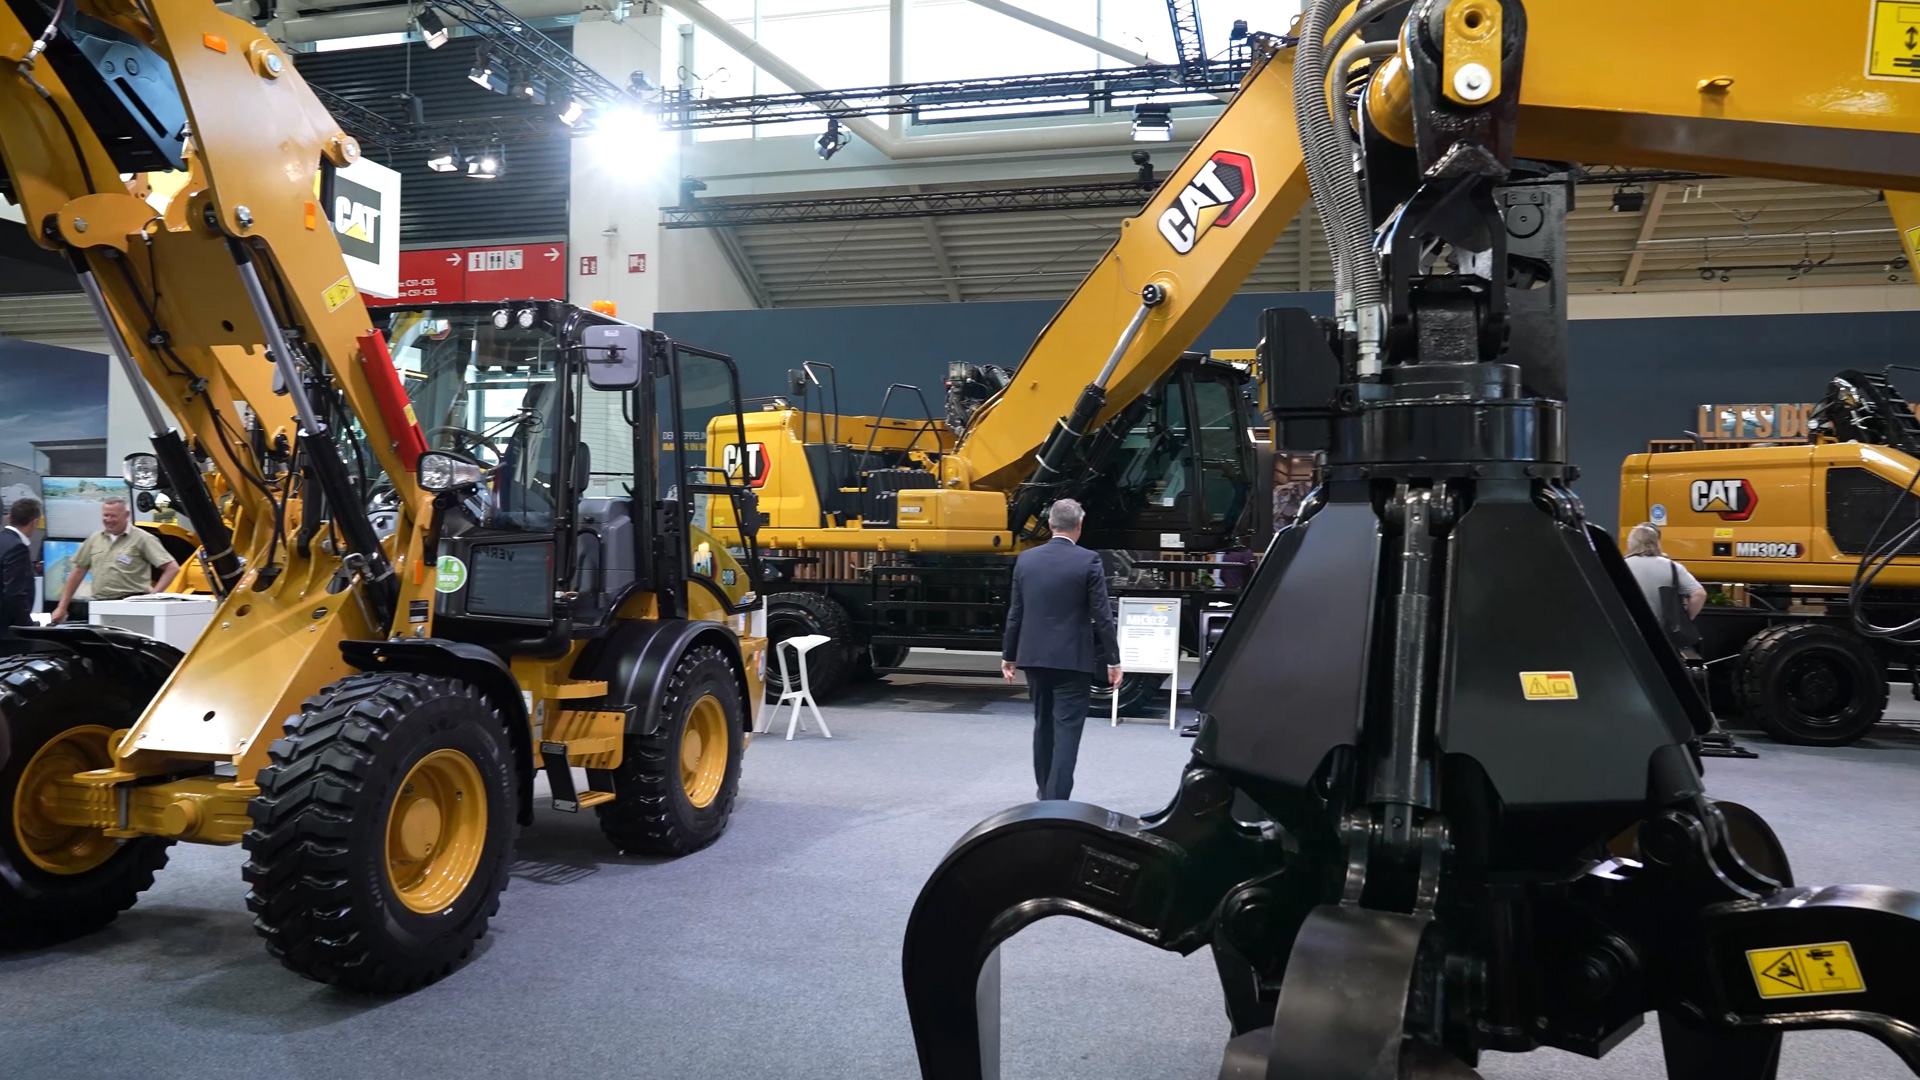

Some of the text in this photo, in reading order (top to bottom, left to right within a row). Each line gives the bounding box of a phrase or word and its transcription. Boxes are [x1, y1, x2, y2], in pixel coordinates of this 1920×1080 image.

[335, 195, 381, 244] CAT
[1158, 159, 1235, 253] CAT
[1700, 404, 1774, 438] LET'S
[723, 443, 761, 479] CAT
[1691, 480, 1742, 512] CAT
[1736, 542, 1798, 558] MH3024
